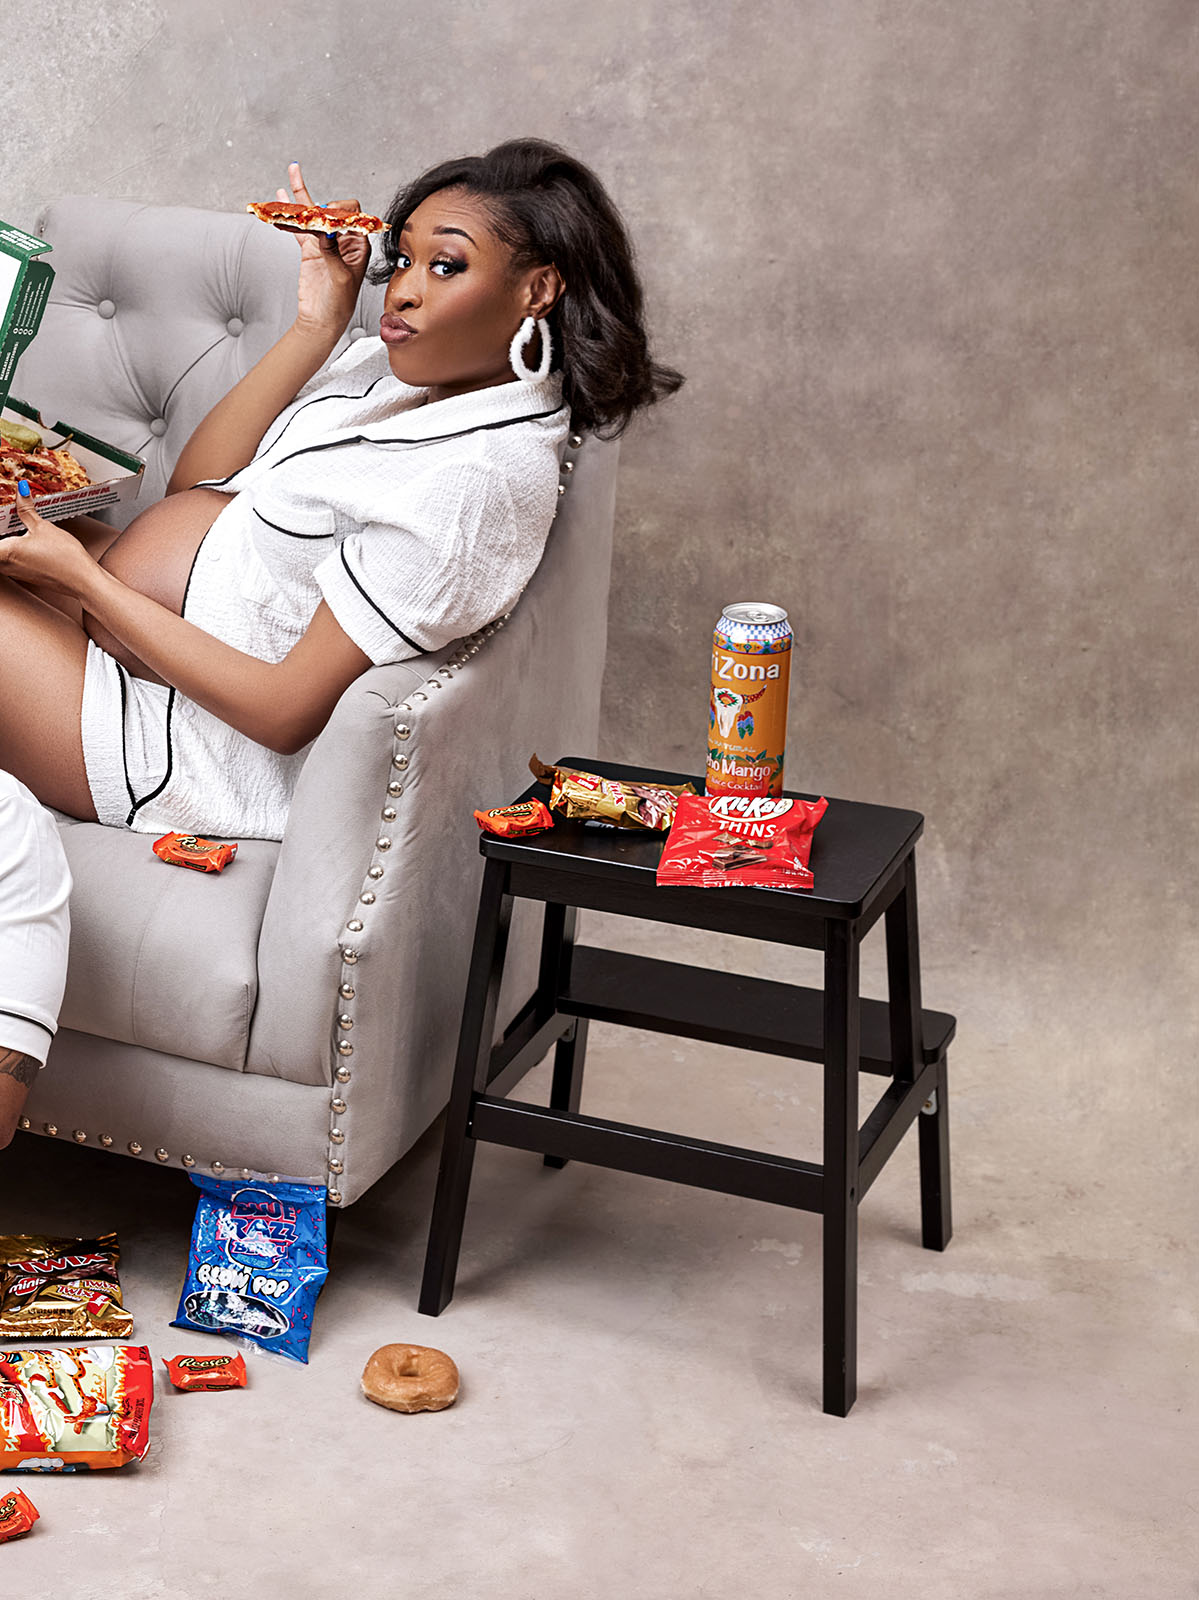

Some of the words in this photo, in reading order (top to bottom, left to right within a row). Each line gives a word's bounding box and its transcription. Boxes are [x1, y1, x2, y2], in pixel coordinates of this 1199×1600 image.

[712, 651, 780, 681] iZona
[721, 759, 771, 781] Mango
[727, 780, 762, 791] Cocktail
[719, 820, 776, 838] THINS
[231, 1204, 295, 1221] BLUE
[217, 1217, 297, 1242] RAZZ
[232, 1241, 288, 1262] BERRY
[8, 1253, 109, 1273] TWIX
[9, 1277, 47, 1294] minis
[83, 1280, 119, 1292] TWIX
[198, 1264, 250, 1289] BLOW
[252, 1276, 290, 1298] POP
[57, 1285, 95, 1298] TWIX
[177, 1357, 231, 1368] Reese's
